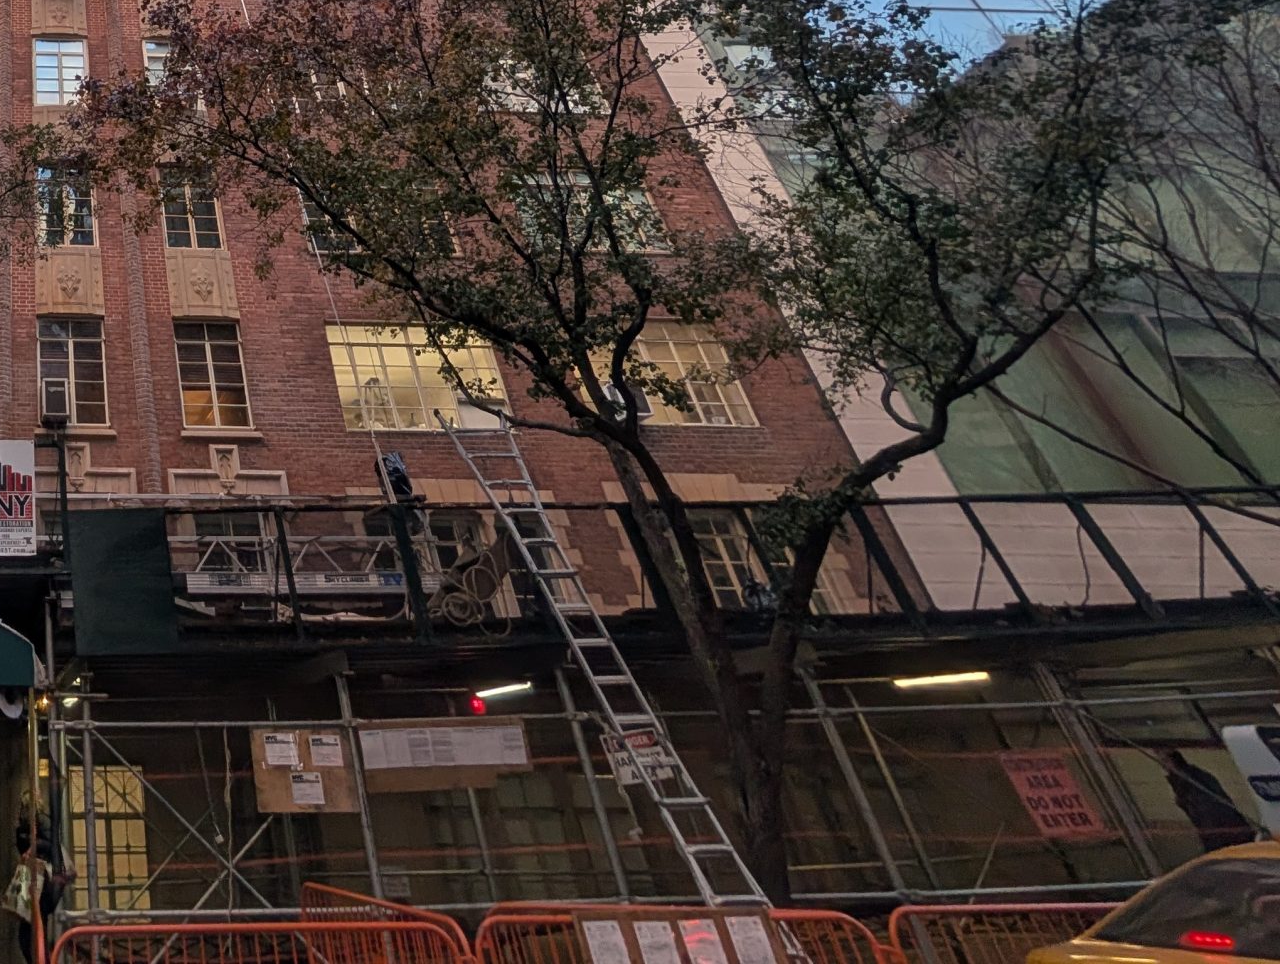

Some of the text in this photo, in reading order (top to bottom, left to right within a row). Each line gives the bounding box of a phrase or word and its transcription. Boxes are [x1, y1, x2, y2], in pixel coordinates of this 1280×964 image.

[1027, 775, 1064, 789] AREA
[1026, 793, 1084, 811] DO NOT
[1040, 811, 1093, 828] ENTER
